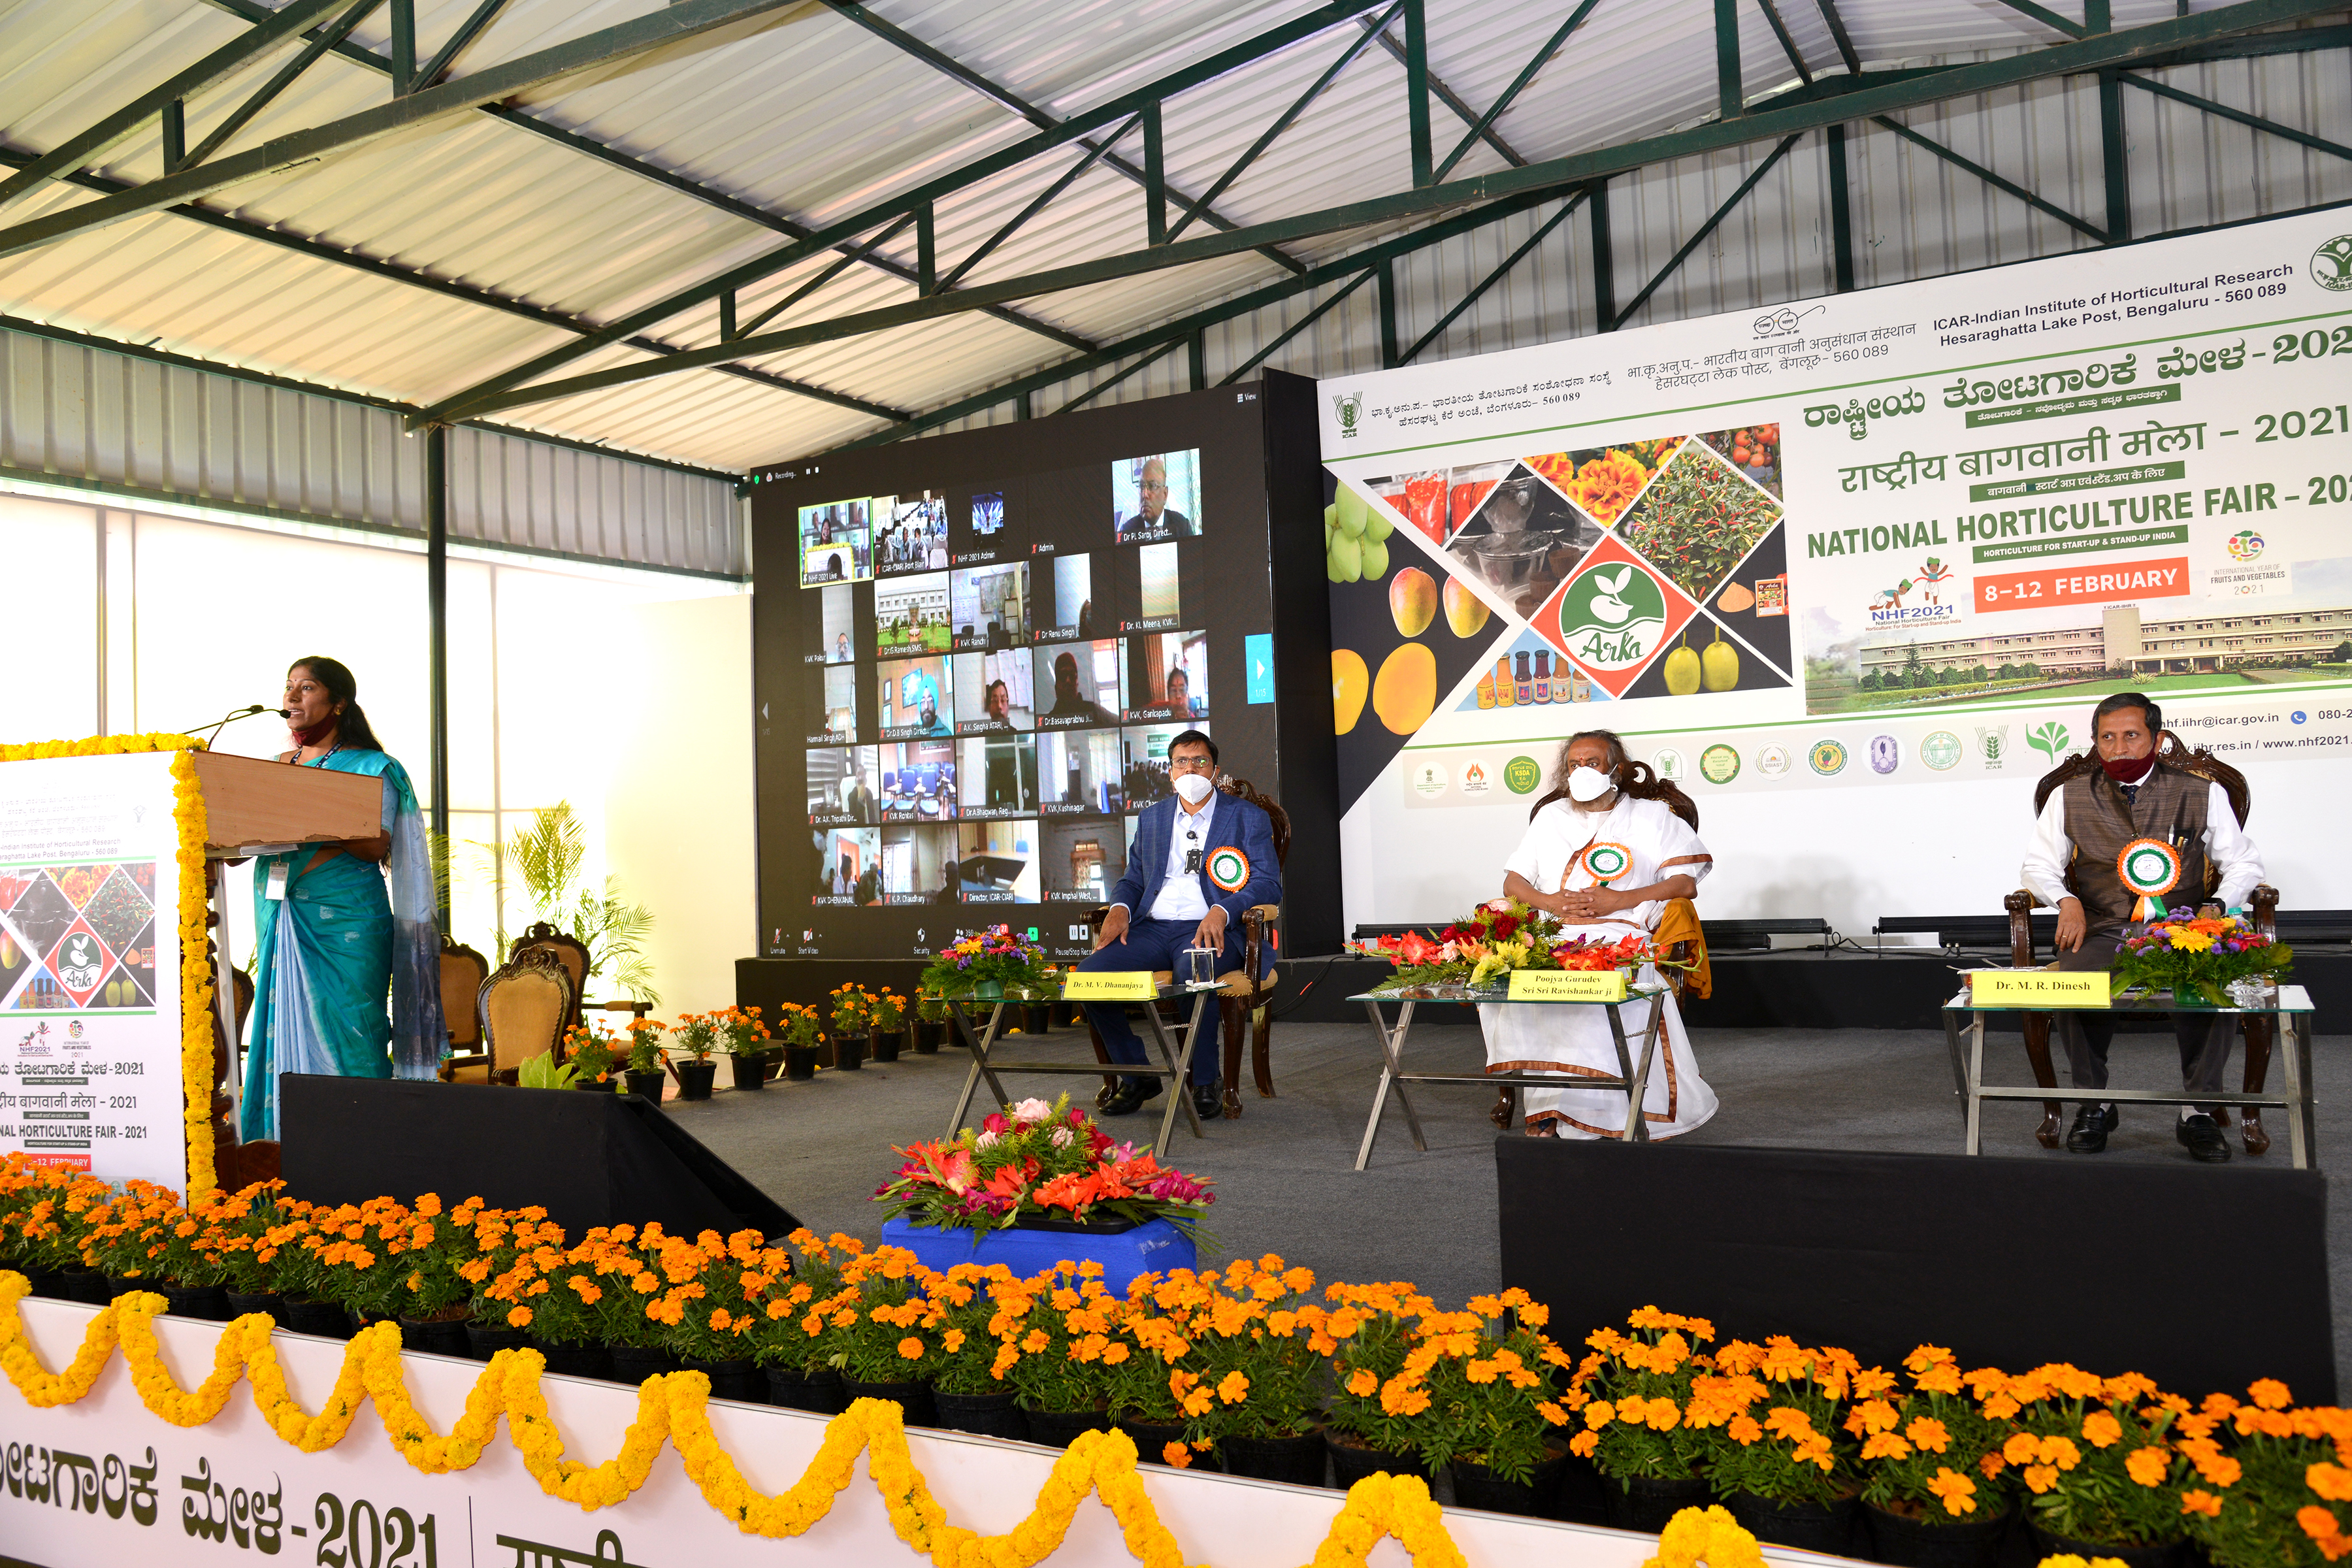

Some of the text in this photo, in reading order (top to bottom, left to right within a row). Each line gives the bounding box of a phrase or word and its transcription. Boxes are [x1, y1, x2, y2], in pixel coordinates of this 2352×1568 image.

[1933, 306, 2021, 331] ICAR-Indian
[2025, 296, 2087, 316] Institute
[2091, 293, 2107, 306] of
[2111, 276, 2209, 303] Horticultural
[2215, 263, 2294, 286] Research
[1940, 282, 2287, 347] Hesaraghatta Lake Post, Bengaluru 560 089
[1704, 350, 1748, 368] भारतीय
[1810, 331, 1867, 351] अनुसंधान
[1871, 323, 1917, 341] संस्थान
[1714, 365, 1737, 380] लेक
[1741, 359, 1772, 376] पोस्ट,
[1834, 350, 1859, 363] 560
[1863, 345, 1889, 359] 089
[1943, 351, 2138, 409] ತೋಟಗಾರಿಕೆ
[1433, 393, 1474, 409] ಭಾರತೀಯ
[1479, 385, 1529, 400] ತೋಟಗಾರಿಕೆ
[1533, 376, 1584, 392] ಸಂಶೋಧನಾ
[1441, 410, 1454, 421] ಕೆರೆ
[1543, 395, 1561, 405] 560
[1563, 392, 1581, 403] 089
[1978, 408, 2023, 420] ತೋಟಗಾರಿಕೆ
[1838, 405, 2349, 493] राष्ट्रीय बागवानी मेला 2021
[1987, 467, 2166, 497] बागवानी स्टार्ट के लिए
[1806, 474, 2352, 558] NATIONAL HORTICULTURE FAIR 20
[1123, 532, 1130, 542] Dr
[1039, 543, 1054, 552] Admin
[1984, 531, 2176, 557] HORTICULTURE FOR START-UP & STAND-UP INDIA
[981, 551, 996, 560] Admin
[904, 562, 915, 570] Port
[2213, 566, 2253, 576] INTERNATIONAL
[2254, 564, 2270, 573] YEAR
[819, 572, 828, 581] 2021
[2055, 568, 2178, 596] FEBRUARY
[2211, 570, 2286, 584] FRUITS AND VEGETABLES
[2234, 583, 2264, 595] 2021
[1871, 604, 1953, 621] NHF2021
[1143, 619, 1162, 630] Meena,
[1901, 615, 1937, 624] Horticulture
[1041, 625, 1075, 639] Dr Renu Singh
[960, 638, 970, 647] KVK
[1579, 632, 1644, 663] Arka
[900, 727, 913, 738] Singh
[973, 722, 989, 732] Singha
[1133, 800, 1144, 809] KVK
[889, 810, 914, 820] KVK Rohtas
[54, 840, 90, 848] Horticultural
[59, 849, 90, 858] Bengaluru
[817, 896, 826, 905] KVK
[902, 893, 925, 904] Chaudhary
[969, 893, 989, 903] Director,
[1051, 891, 1092, 902] KVK Imphal West,
[913, 947, 930, 956] Security
[1055, 948, 1080, 957] Pause/Stop
[66, 968, 93, 988] Arka
[1535, 975, 1563, 984] Poojya
[1104, 981, 1143, 990] Dhananjaya
[1996, 981, 2091, 990] Dr. M. R. Dinesh
[1550, 987, 1603, 995] Ravishankar
[1605, 988, 1612, 997] ji
[14, 1061, 76, 1075] ತೋಟಗಾರಿಕೆ
[19, 1092, 67, 1109] बागवानी
[70, 1092, 97, 1109] मेला
[110, 1096, 137, 1109] 2021
[19, 1124, 92, 1138] HORTICULTURE
[95, 1126, 117, 1138] FAIR
[125, 1126, 147, 1139] 2021
